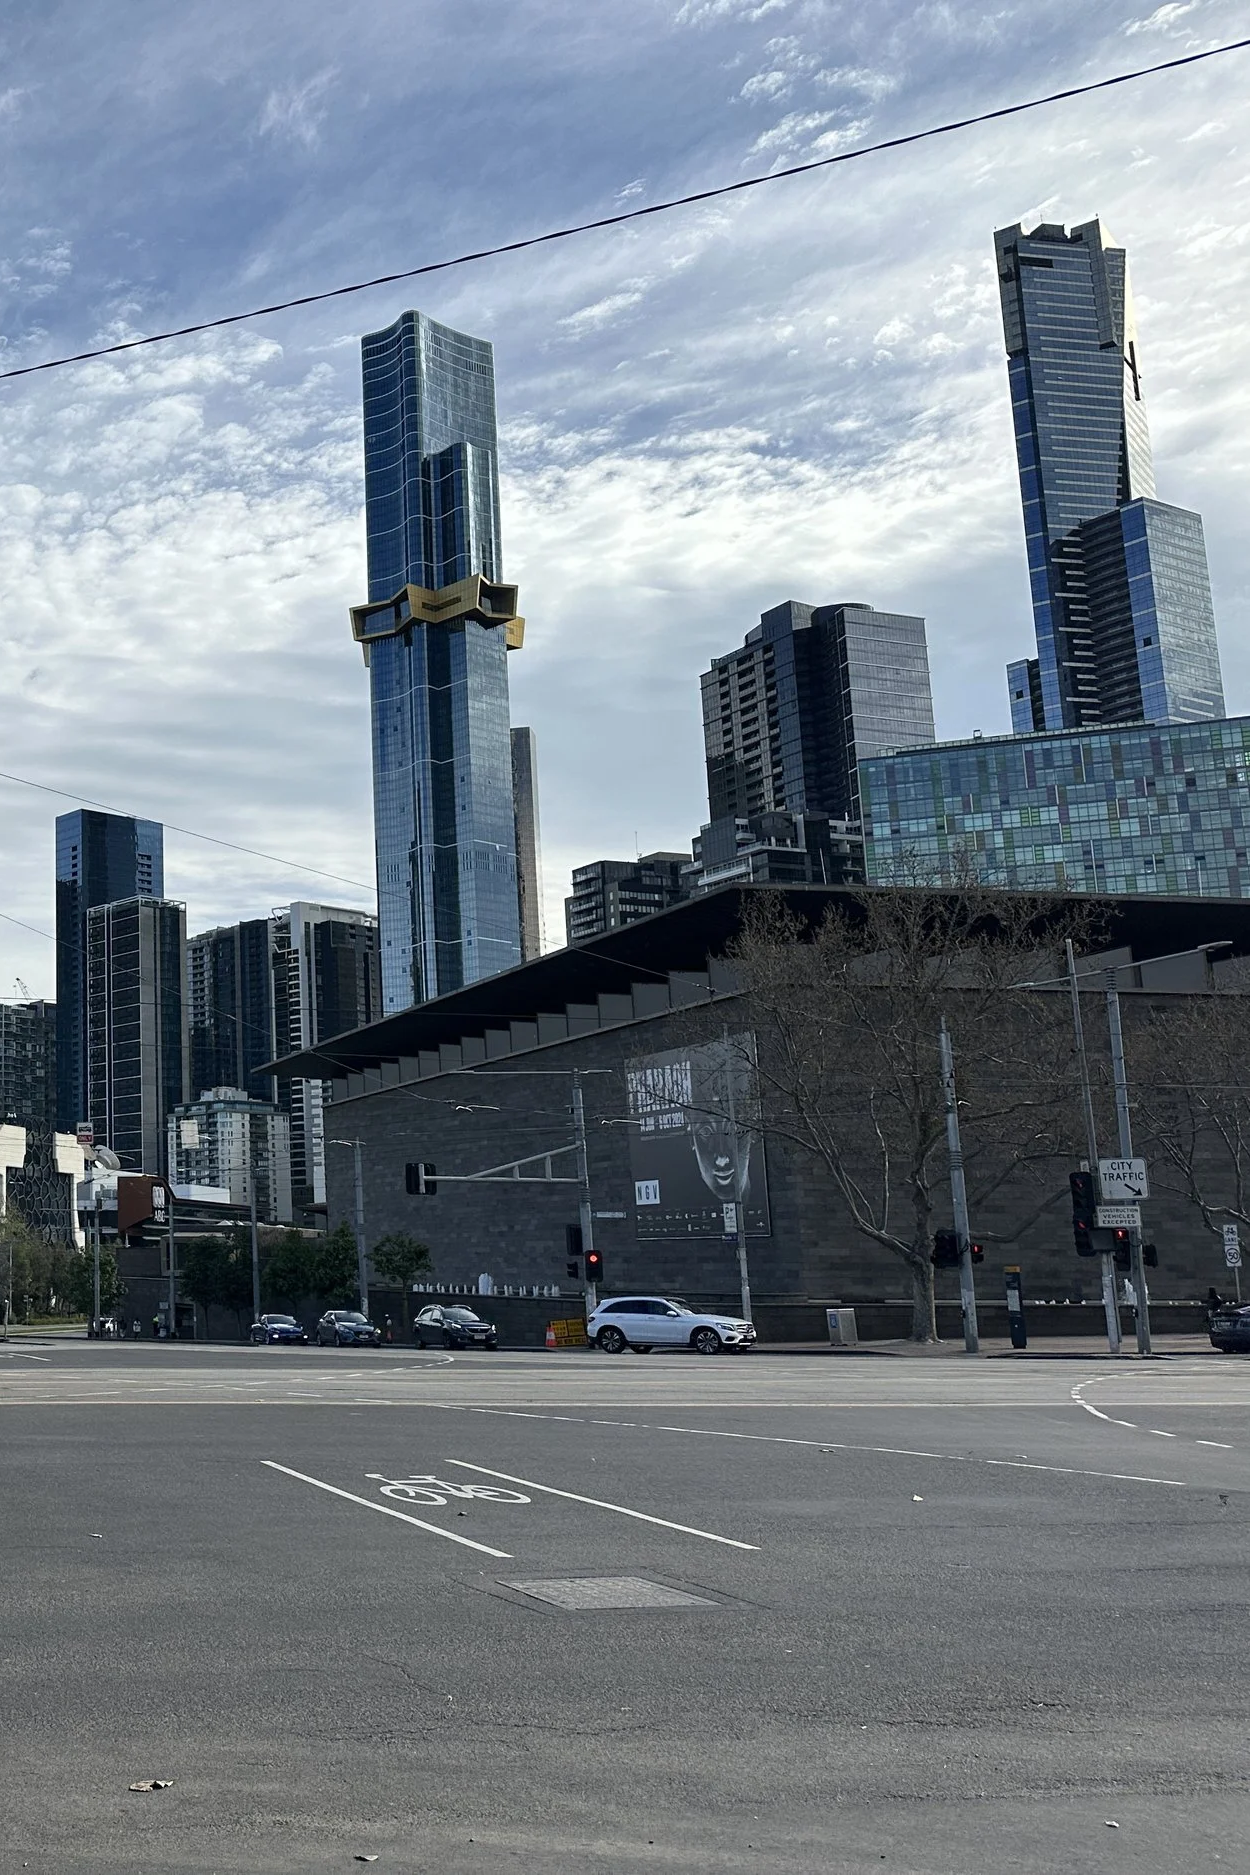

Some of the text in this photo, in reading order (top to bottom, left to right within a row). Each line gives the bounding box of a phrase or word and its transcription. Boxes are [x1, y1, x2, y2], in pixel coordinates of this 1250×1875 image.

[1110, 1161, 1133, 1171] CITY
[1102, 1172, 1144, 1181] TRAFFIC
[637, 1184, 658, 1201] NGV
[153, 1209, 166, 1223] ABC
[1227, 1251, 1239, 1260] 50
